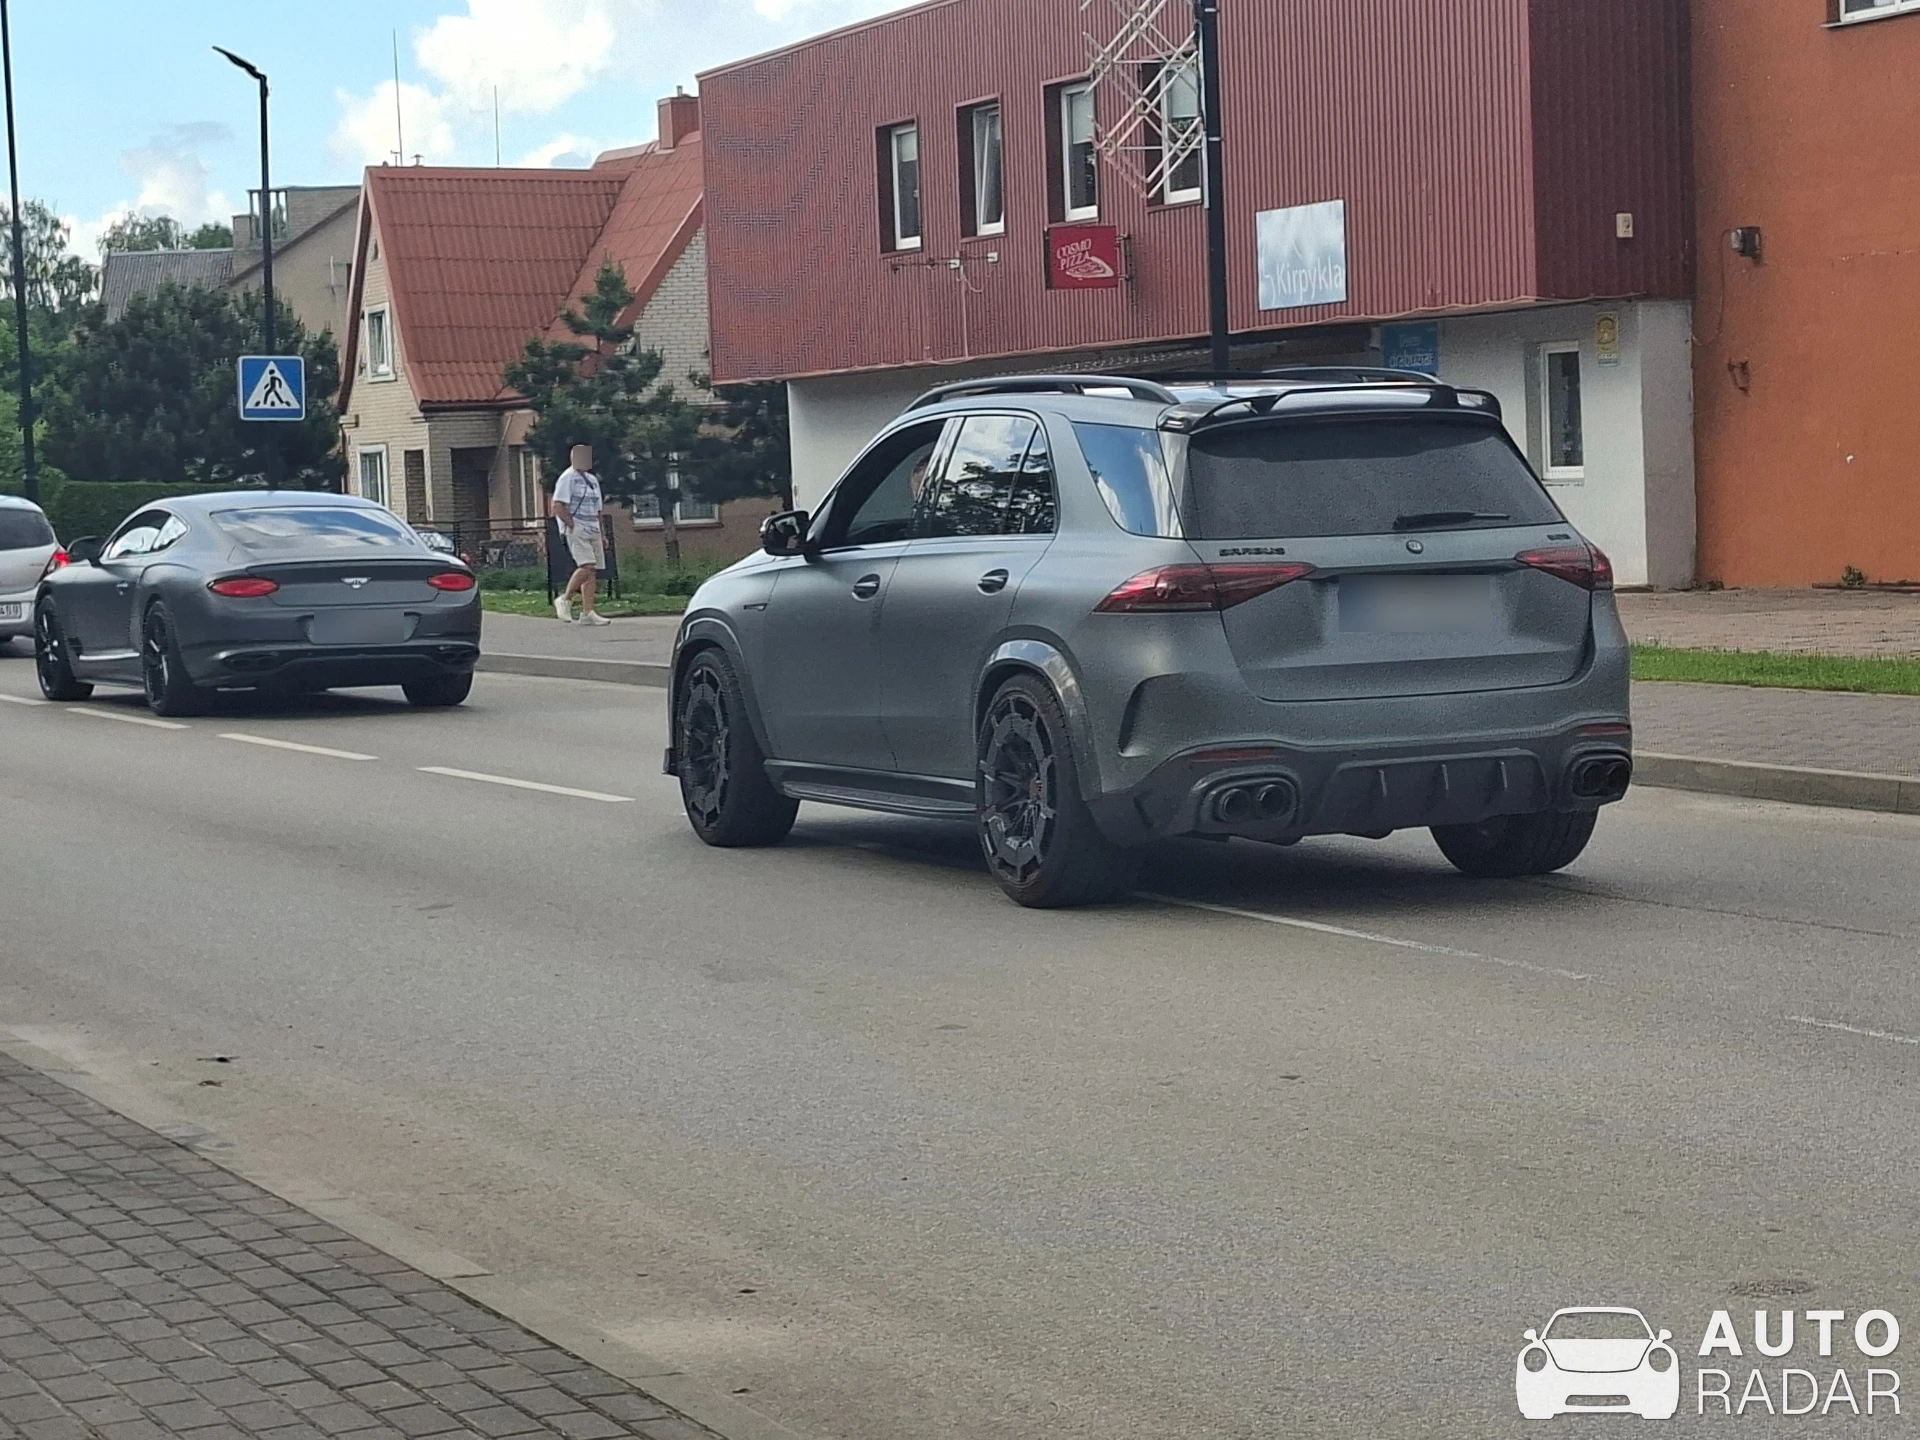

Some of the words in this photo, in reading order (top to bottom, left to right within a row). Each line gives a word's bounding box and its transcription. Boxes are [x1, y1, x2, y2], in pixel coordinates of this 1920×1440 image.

[1057, 238, 1092, 259] COSMO
[1058, 251, 1090, 270] PIZZA
[1276, 255, 1343, 302] Kirpykla
